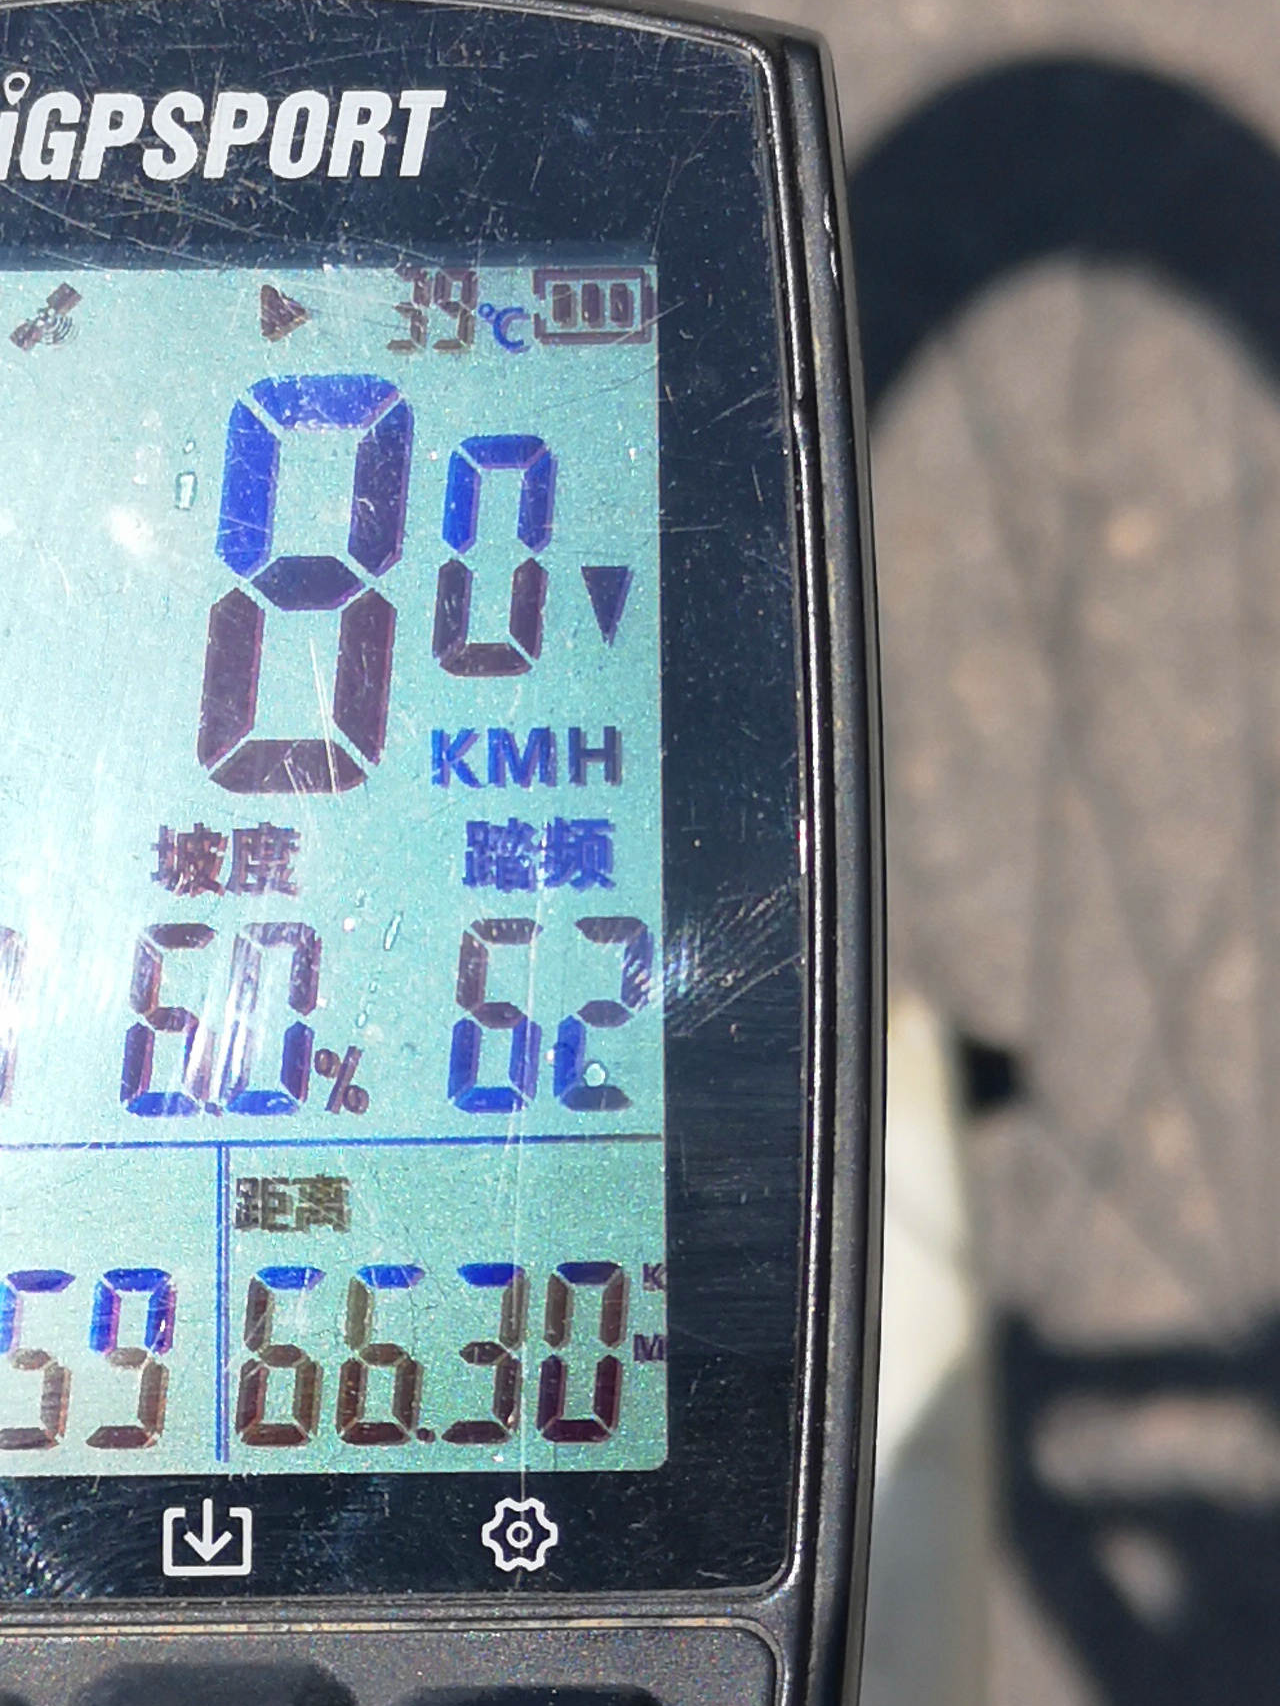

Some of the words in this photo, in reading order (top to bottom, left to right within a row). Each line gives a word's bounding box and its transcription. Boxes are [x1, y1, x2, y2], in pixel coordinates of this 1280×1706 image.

[431, 725, 623, 790] KMH
[150, 821, 302, 897] 坡度
[462, 816, 617, 893] 踏频
[448, 916, 655, 1115] 62
[234, 1174, 353, 1233] 距离
